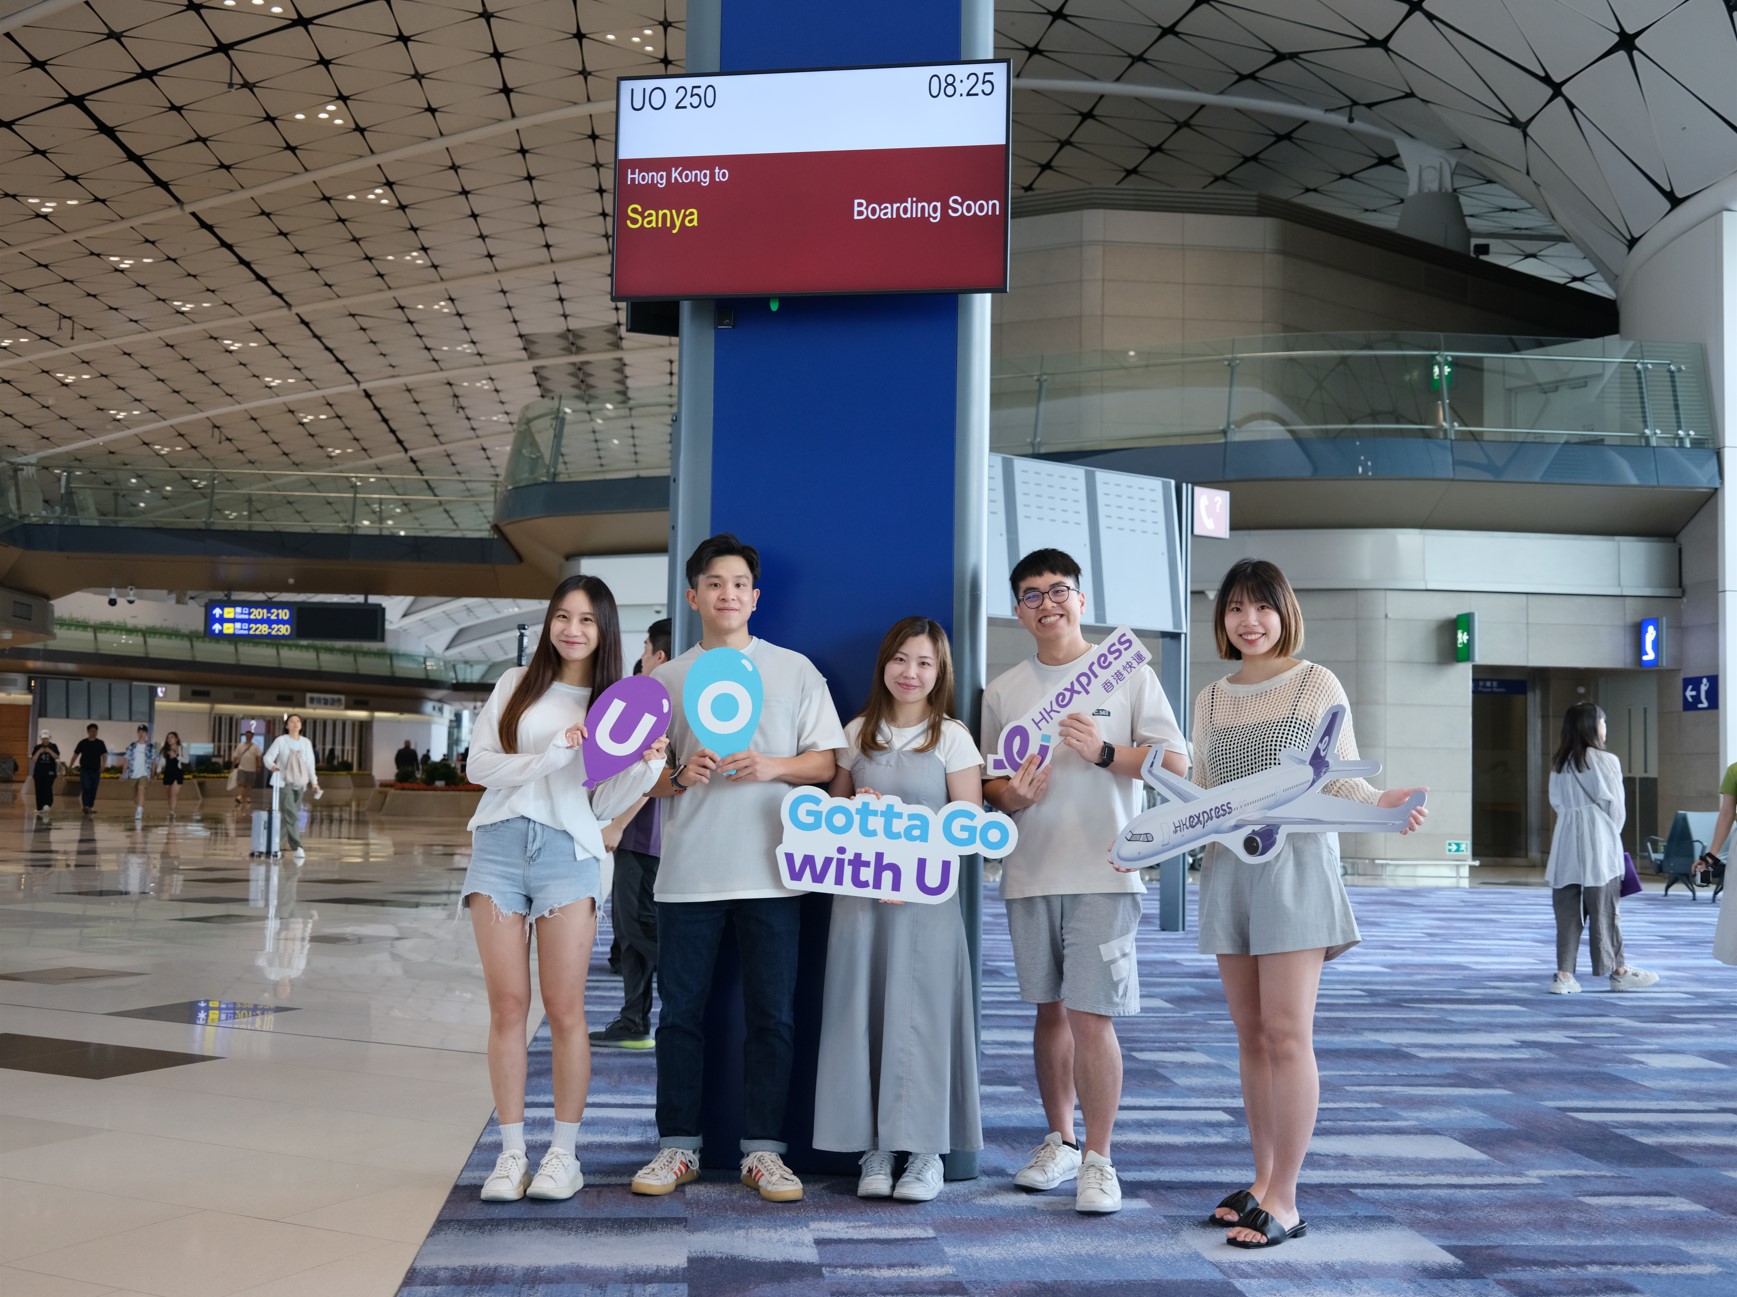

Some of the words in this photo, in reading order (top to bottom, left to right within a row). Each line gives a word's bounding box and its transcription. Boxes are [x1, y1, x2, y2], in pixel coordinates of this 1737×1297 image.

[630, 87, 667, 111] UO
[675, 84, 717, 109] 250
[928, 72, 995, 98] 08:25
[627, 168, 667, 188] Hong
[671, 167, 711, 186] Kong
[714, 166, 729, 182] to
[626, 204, 698, 234] Sanya
[853, 198, 941, 223] Boarding
[948, 196, 1000, 217] Soon
[249, 607, 290, 620] 201-210
[249, 623, 291, 635] 228-230
[1031, 632, 1133, 731] HKexpress
[1101, 650, 1146, 693] 香港快運
[698, 680, 753, 734] O
[595, 698, 658, 757] U
[788, 794, 930, 843] Gotta
[942, 809, 1010, 851] Go
[1172, 801, 1233, 833] HKexpress
[784, 846, 902, 892] with
[915, 857, 952, 897] U
